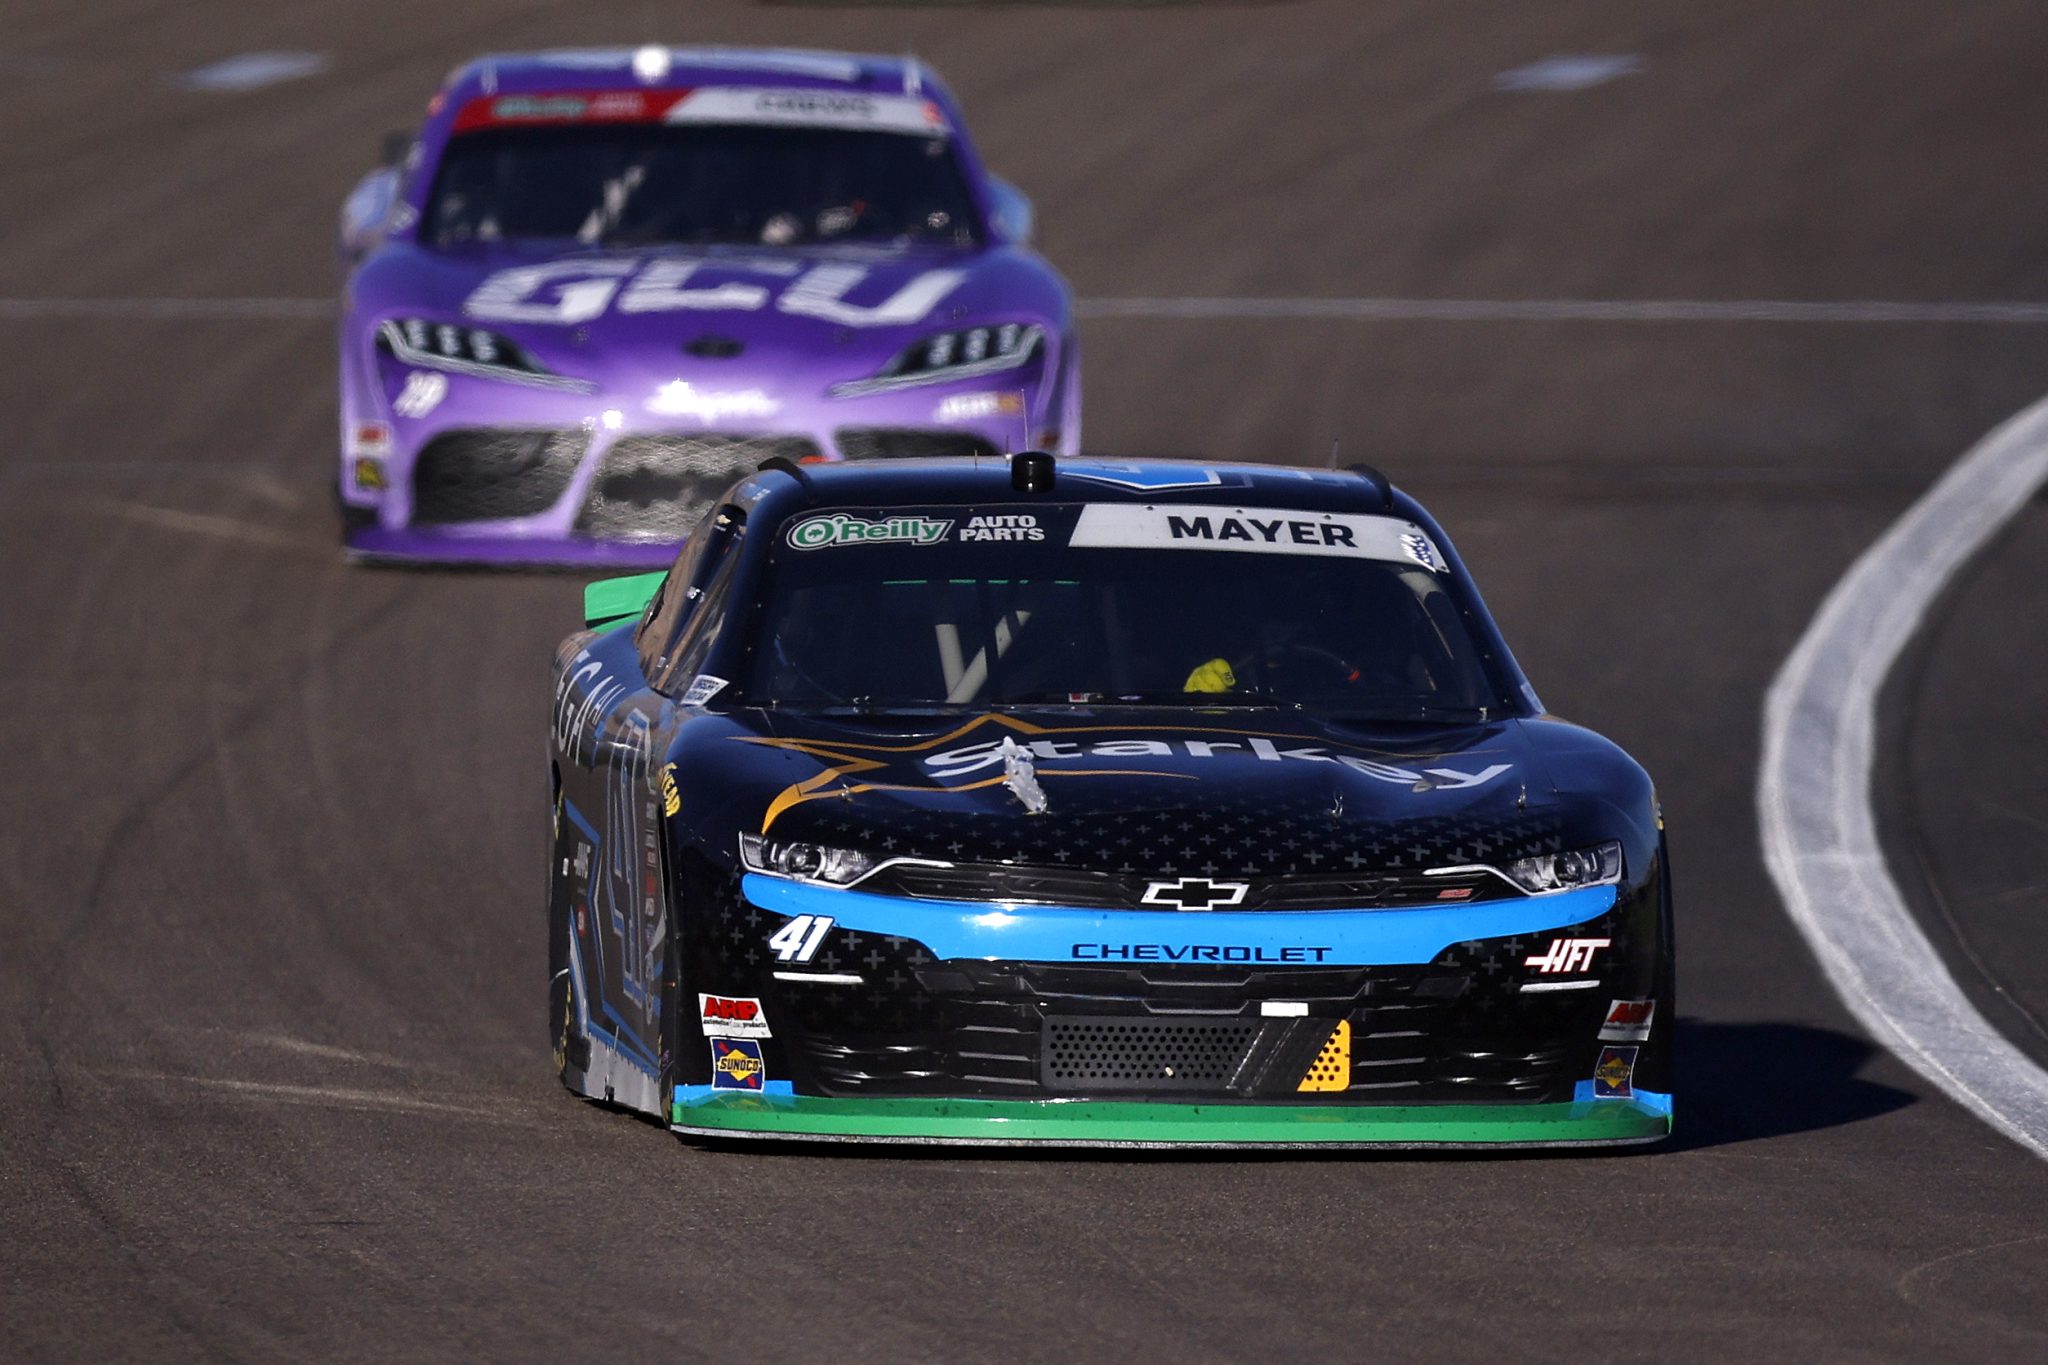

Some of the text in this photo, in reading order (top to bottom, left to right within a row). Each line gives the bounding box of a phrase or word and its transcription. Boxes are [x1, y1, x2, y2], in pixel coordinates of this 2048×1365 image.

[463, 258, 968, 328] GCU
[790, 514, 949, 548] O'Reilly
[959, 527, 1045, 541] PARTS
[967, 515, 1037, 528] AUTO
[1167, 515, 1359, 548] MAYER
[925, 737, 1514, 790] Starkey
[769, 914, 834, 961] 41
[1072, 943, 1332, 962] CHEVROLET
[1524, 939, 1611, 972] HFT
[703, 997, 758, 1020] ARP
[719, 1058, 759, 1071] SUNOCO
